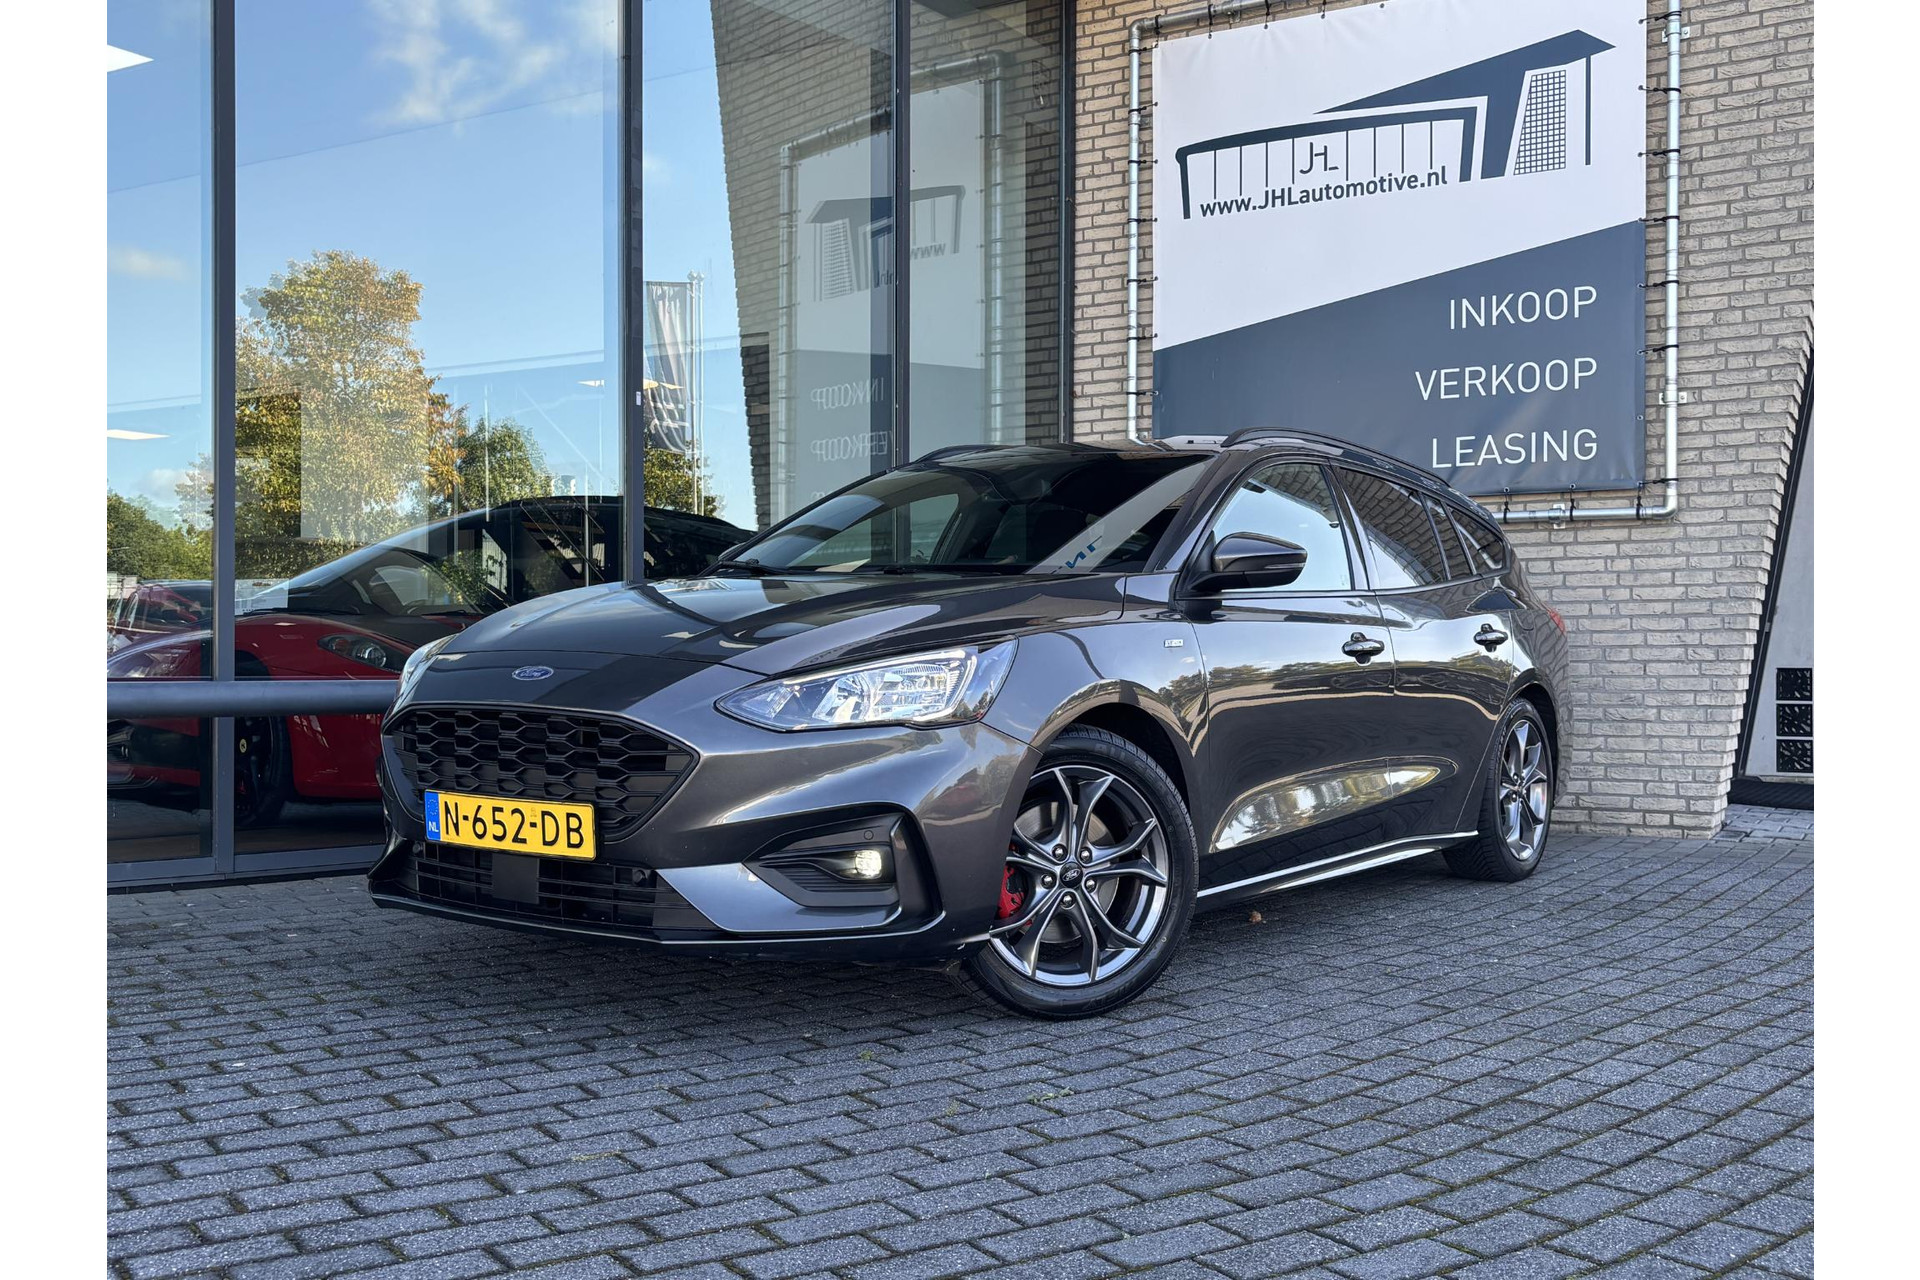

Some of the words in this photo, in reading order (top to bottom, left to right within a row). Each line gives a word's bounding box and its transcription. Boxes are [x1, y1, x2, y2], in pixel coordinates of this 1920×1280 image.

[1200, 165, 1448, 218] www.JHLautomotive.nl
[1450, 285, 1597, 330] INKOOP
[1415, 357, 1597, 401] VERKOOP
[1432, 428, 1597, 469] LEASING
[428, 821, 439, 833] NL
[444, 800, 585, 849] N-652-DB
